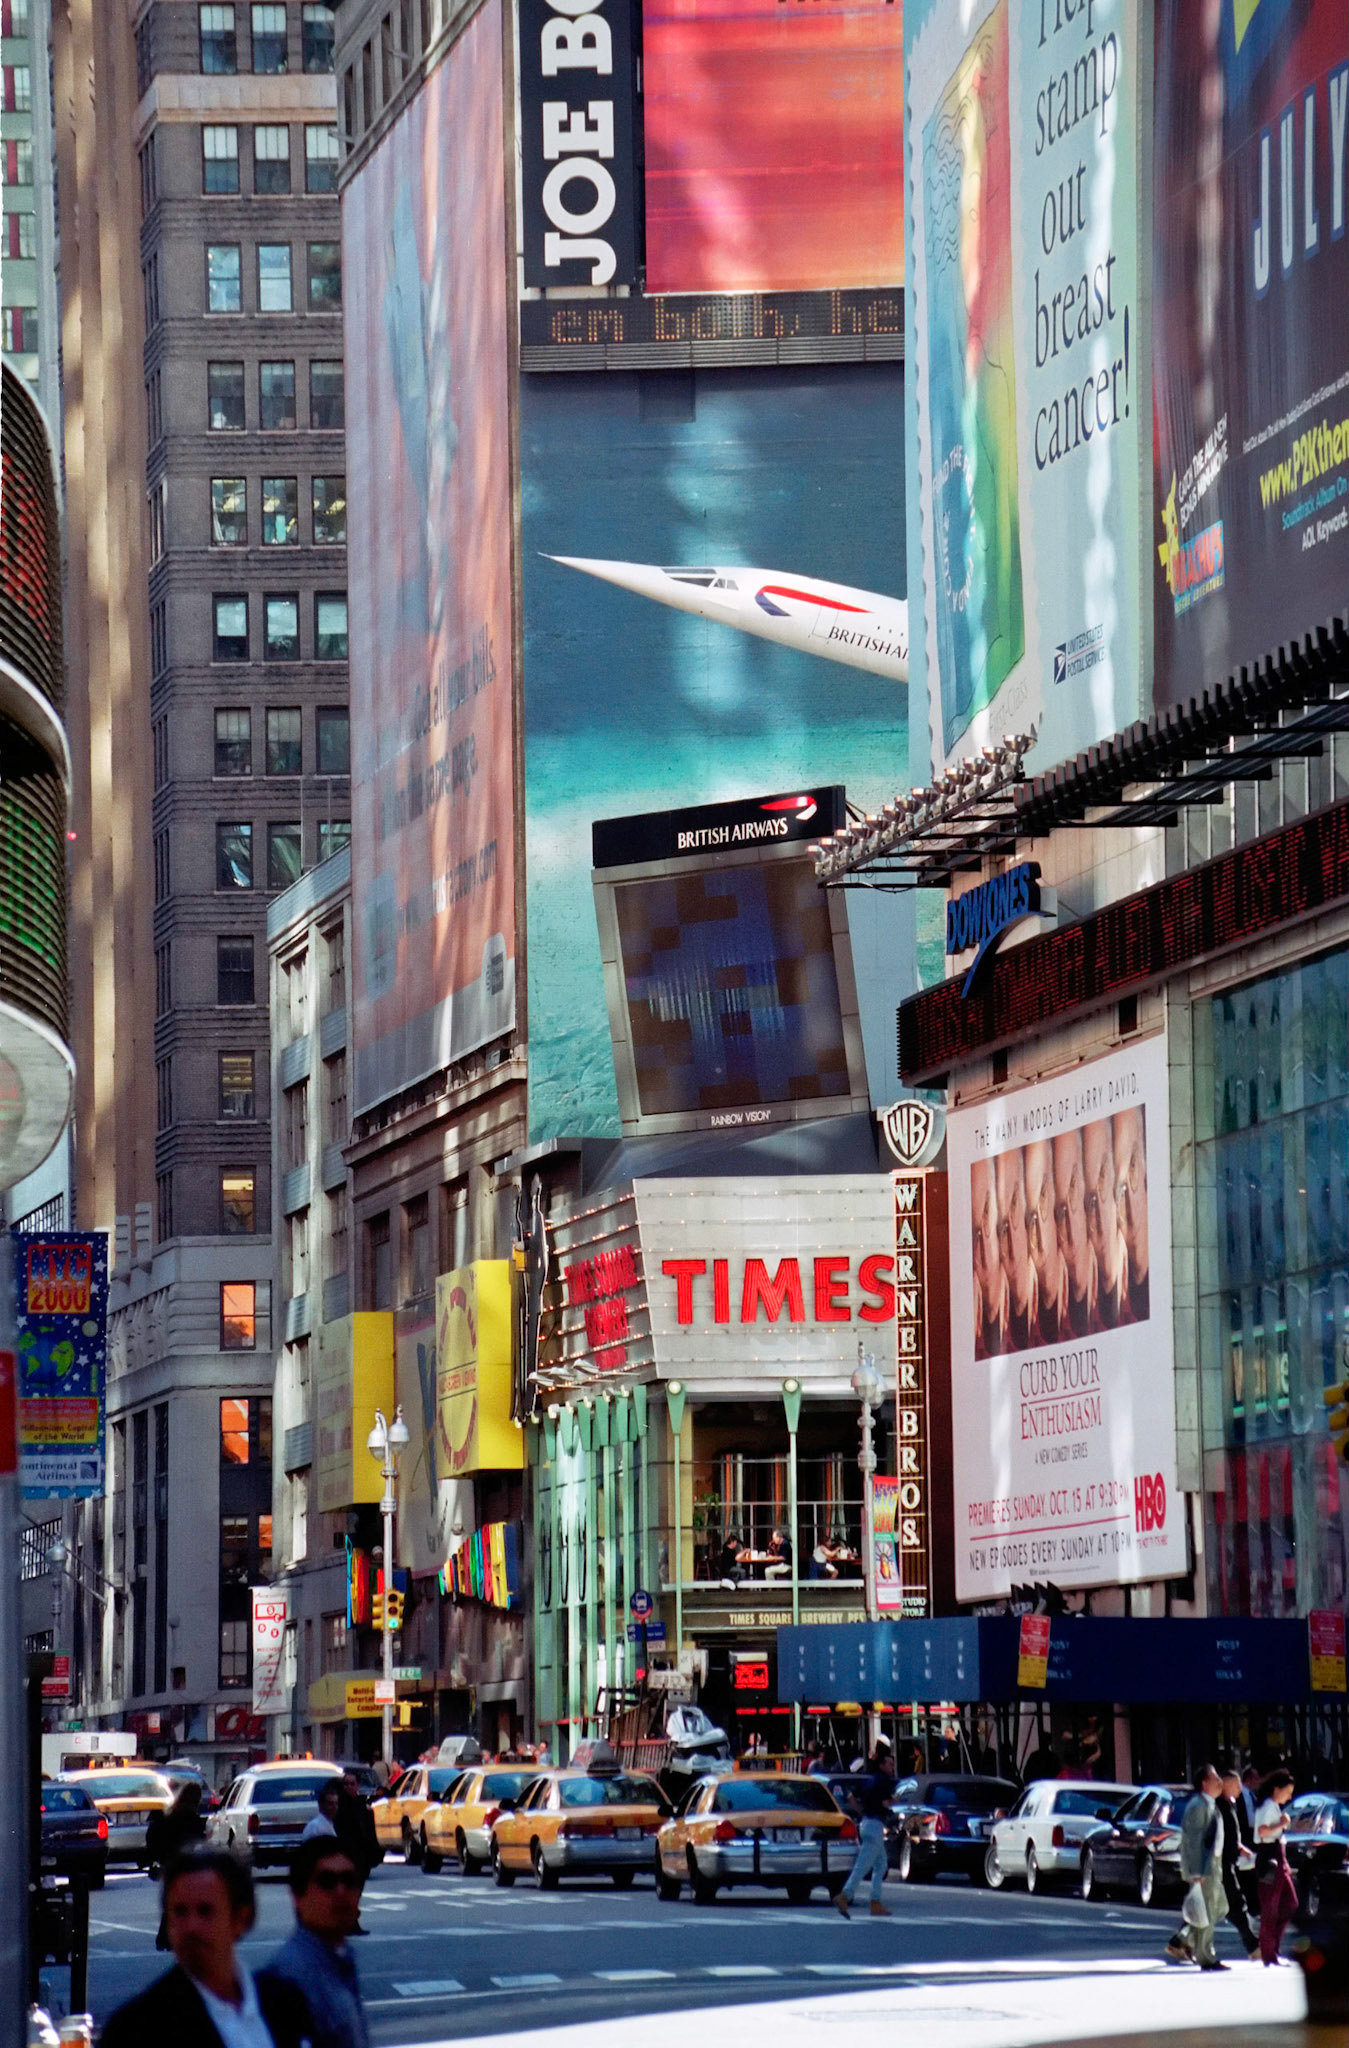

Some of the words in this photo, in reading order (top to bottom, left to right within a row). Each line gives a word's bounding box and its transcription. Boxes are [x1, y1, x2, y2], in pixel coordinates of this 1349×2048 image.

[540, 0, 613, 77] B
[1035, 31, 1118, 156] stamp
[542, 100, 617, 286] JOE
[1253, 66, 1349, 292] JULY
[1041, 160, 1086, 256] out
[552, 309, 625, 343] em
[1035, 249, 1116, 368] breast
[1035, 304, 1130, 471] cancer!
[677, 825, 730, 850] BRITISH
[731, 817, 789, 842] AIRWAYS
[711, 1112, 743, 1126] RAINBOW
[994, 1116, 1018, 1140] ANY
[1022, 1104, 1054, 1132] MOODS
[1057, 1098, 1070, 1123] OF
[1075, 1087, 1103, 1116] LARRY
[30, 1248, 89, 1281] NYC
[661, 1254, 895, 1325] TIMES
[894, 1184, 919, 1390] WARNER
[30, 1280, 88, 1312] 2000
[1019, 1357, 1059, 1398] CURB
[1060, 1347, 1100, 1391] YOUR
[61, 1432, 85, 1441] World
[1020, 1395, 1102, 1440] ENTHUSIASM
[20, 1461, 77, 1471] ontinental
[968, 1498, 1011, 1528] PREMIERES
[1072, 1487, 1083, 1513] 15
[1085, 1484, 1096, 1511] AT
[1098, 1481, 1118, 1509] 9:30
[1134, 1471, 1167, 1533] HBO
[969, 1549, 987, 1571] NEW
[1031, 1539, 1057, 1564] EVERY
[1061, 1535, 1095, 1561] SUNDAY
[1097, 1532, 1108, 1553] AT
[1110, 1530, 1121, 1552] 10
[729, 1612, 756, 1626] TIMES
[758, 1612, 792, 1626] SQUARE
[801, 1612, 841, 1625] BREWERY
